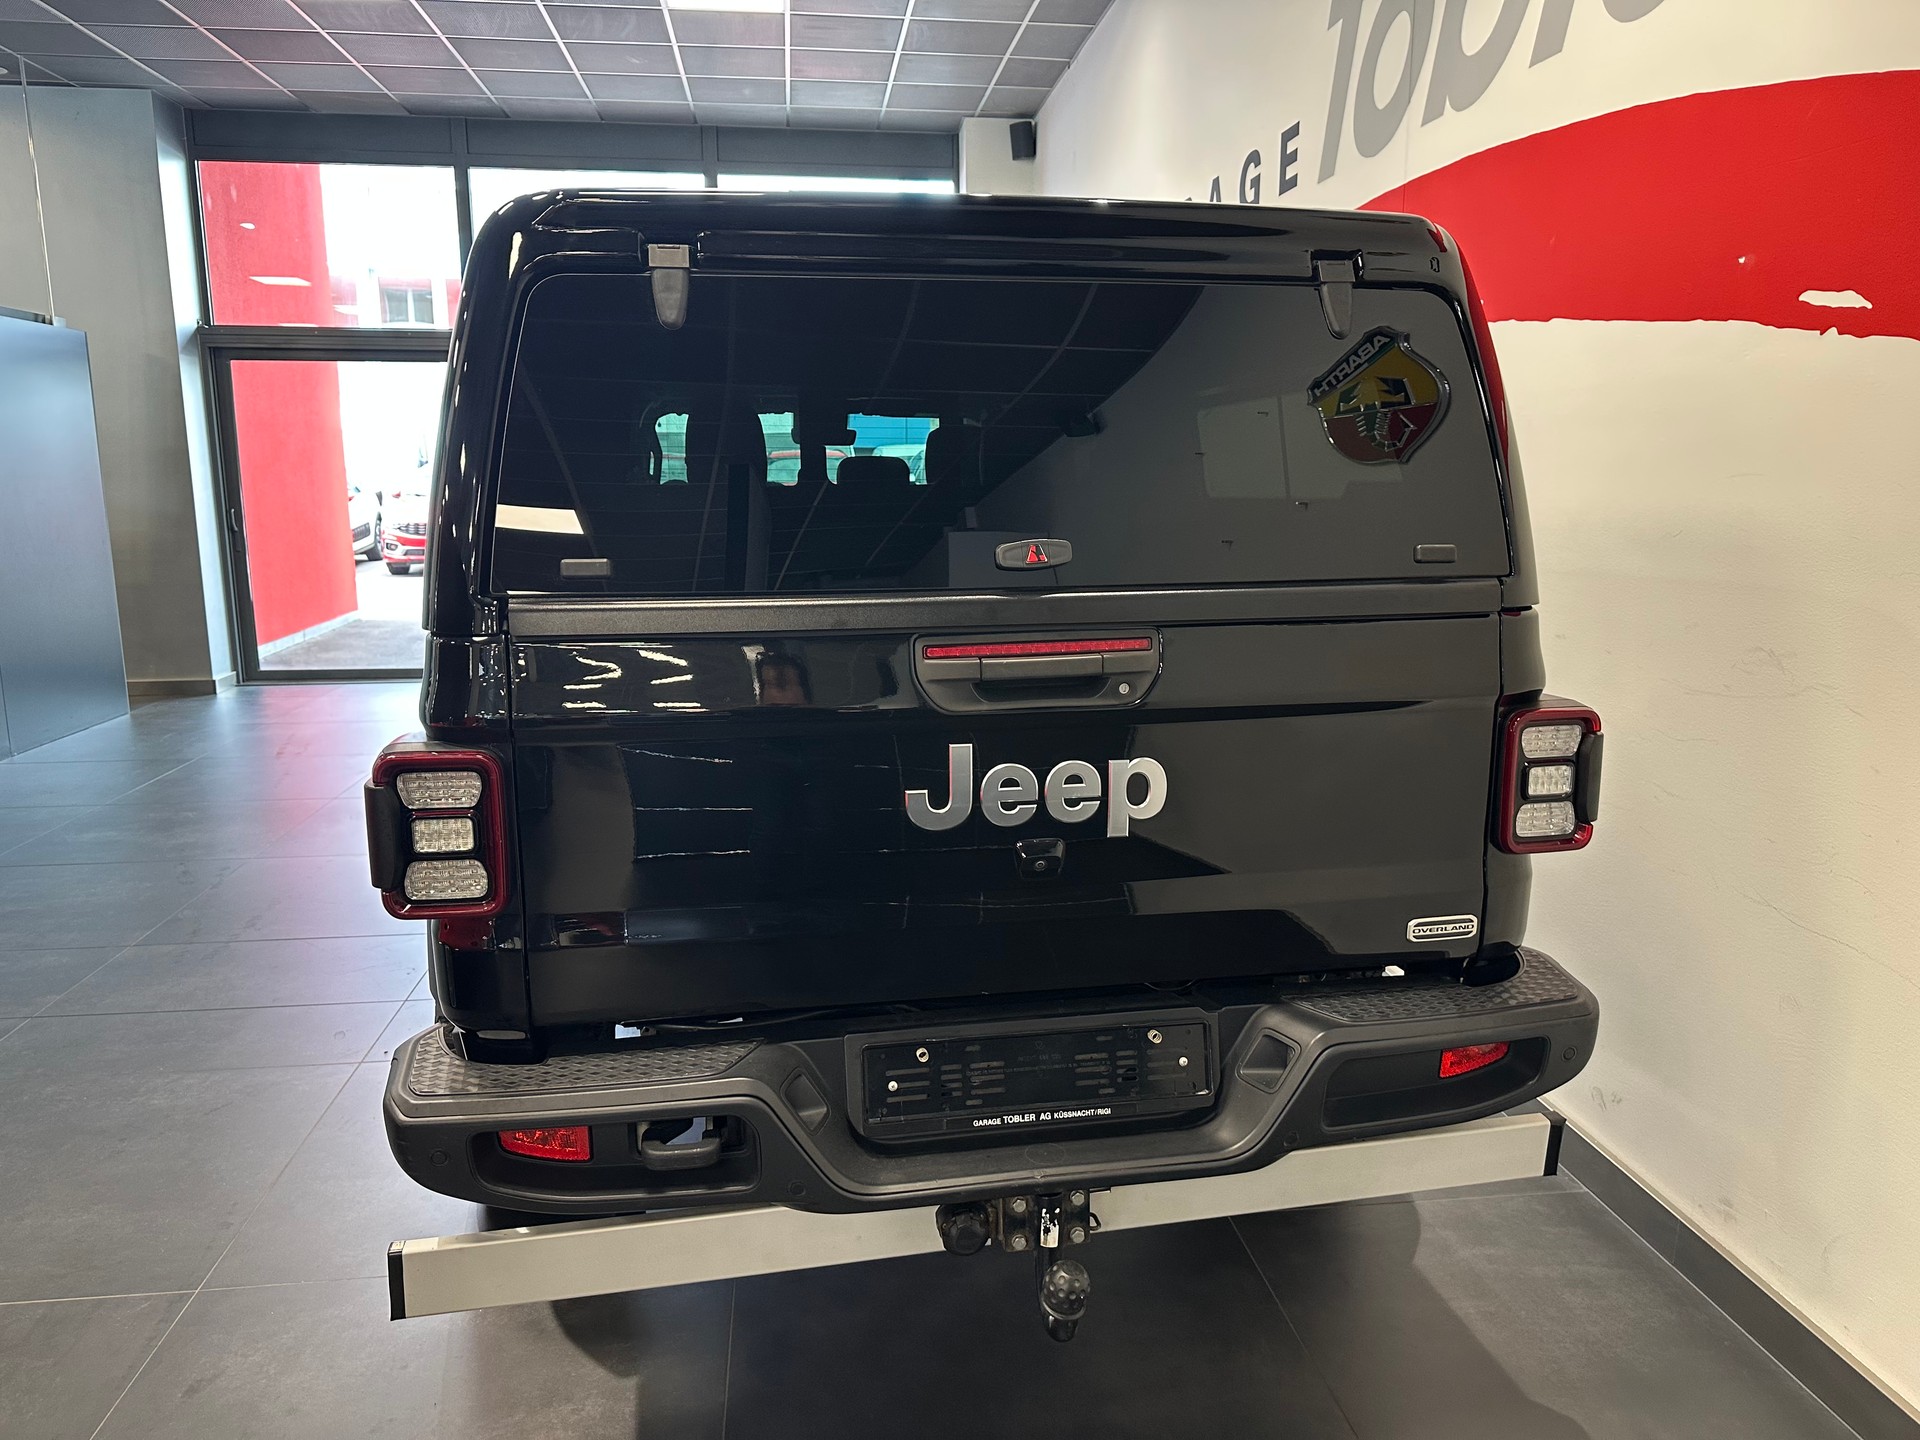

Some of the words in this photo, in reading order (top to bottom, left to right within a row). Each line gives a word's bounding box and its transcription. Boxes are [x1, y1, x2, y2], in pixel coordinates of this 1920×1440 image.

[1184, 121, 1300, 204] AGE
[904, 743, 1168, 838] Jeep
[1412, 924, 1475, 935] OVERLAND
[973, 1117, 1002, 1127] GARAGE
[1002, 1113, 1036, 1124] TOBLER
[1039, 1111, 1052, 1121] AG
[1053, 1107, 1112, 1120] KÜSSNACHT/RIGI
